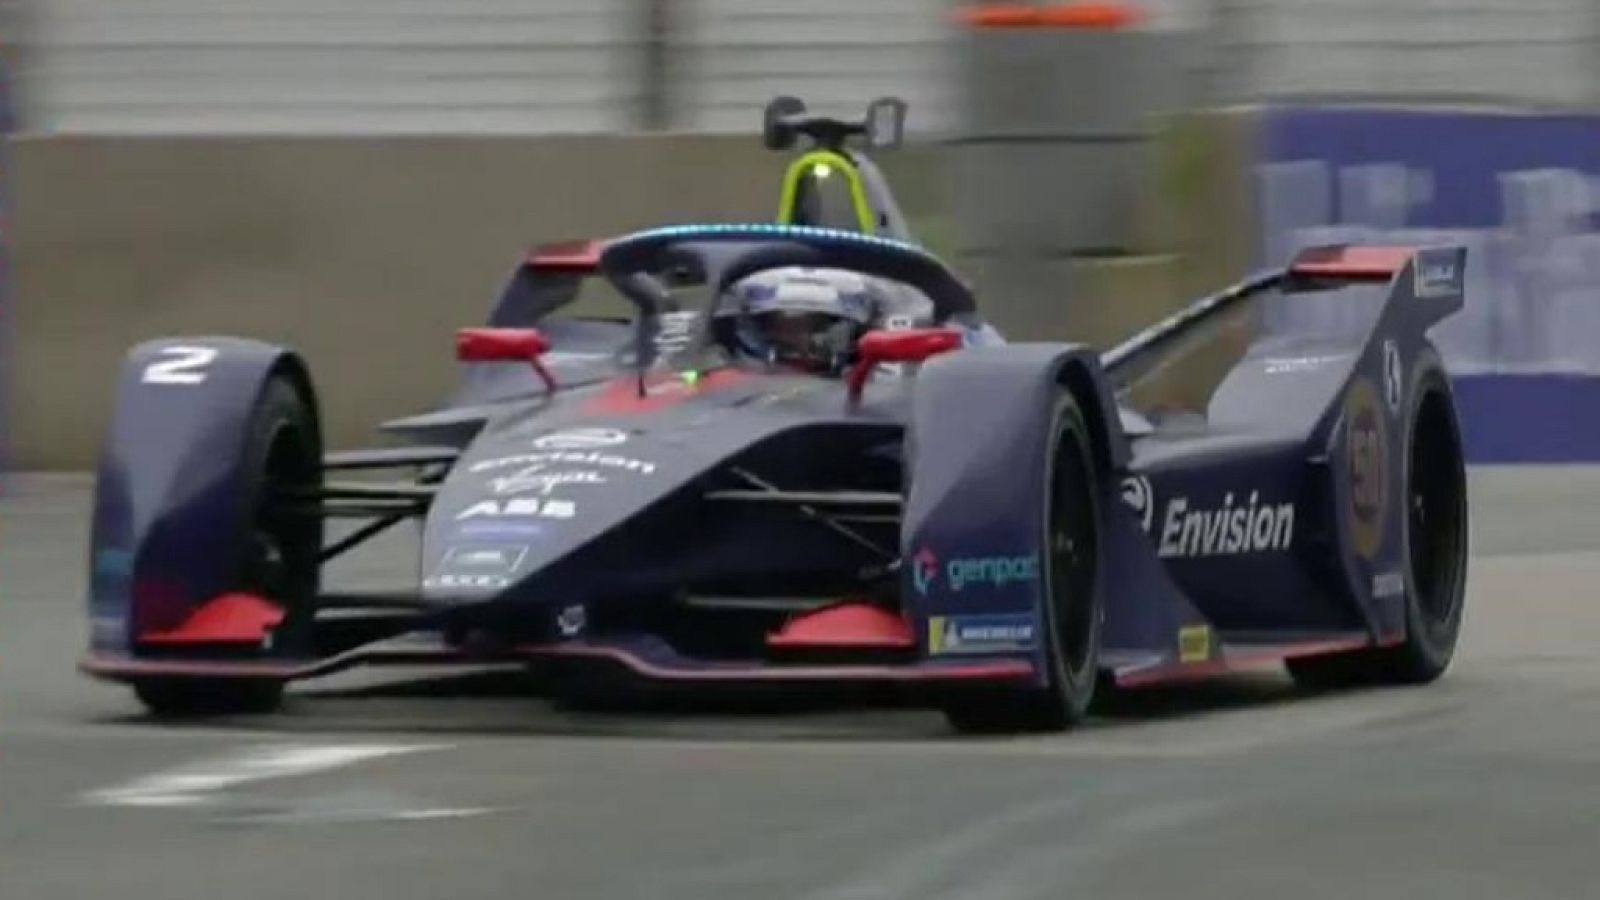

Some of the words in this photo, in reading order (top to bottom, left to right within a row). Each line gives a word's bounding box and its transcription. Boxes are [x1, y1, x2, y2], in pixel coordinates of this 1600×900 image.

[140, 346, 220, 384] 2
[455, 498, 576, 521] ABB
[1158, 489, 1294, 558] Envision
